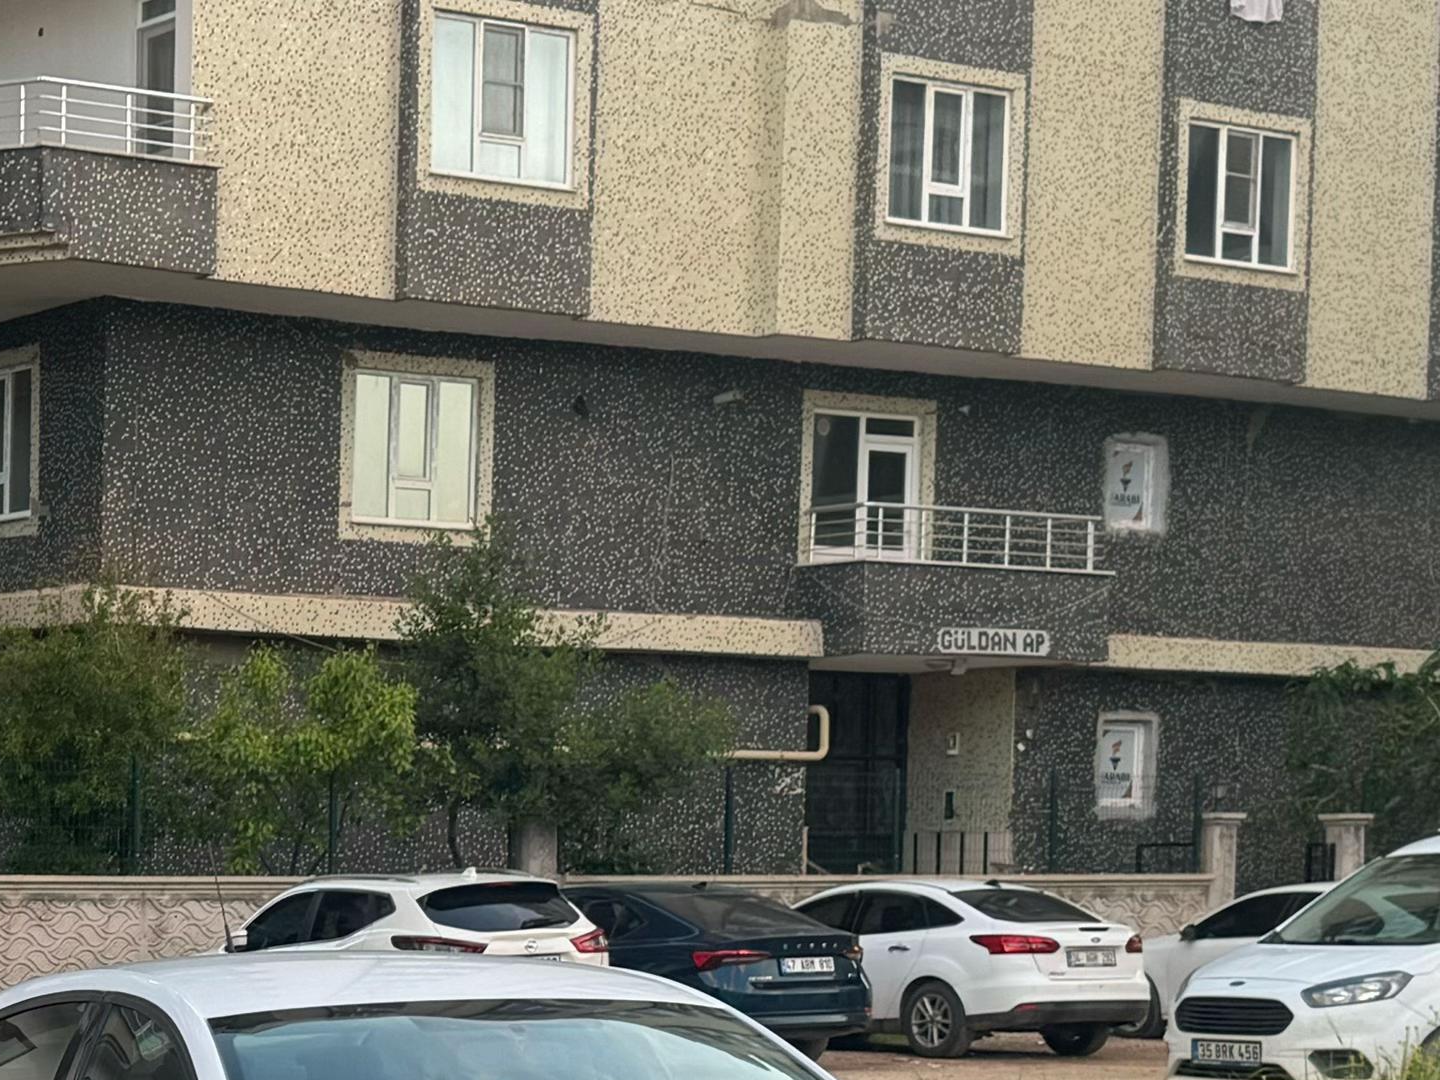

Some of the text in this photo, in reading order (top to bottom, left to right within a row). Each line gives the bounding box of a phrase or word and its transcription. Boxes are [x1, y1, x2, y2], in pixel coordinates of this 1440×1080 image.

[941, 629, 1045, 653] GÜLDAN AP
[1199, 1043, 1213, 1058] 35
[1238, 1045, 1259, 1061] 456
